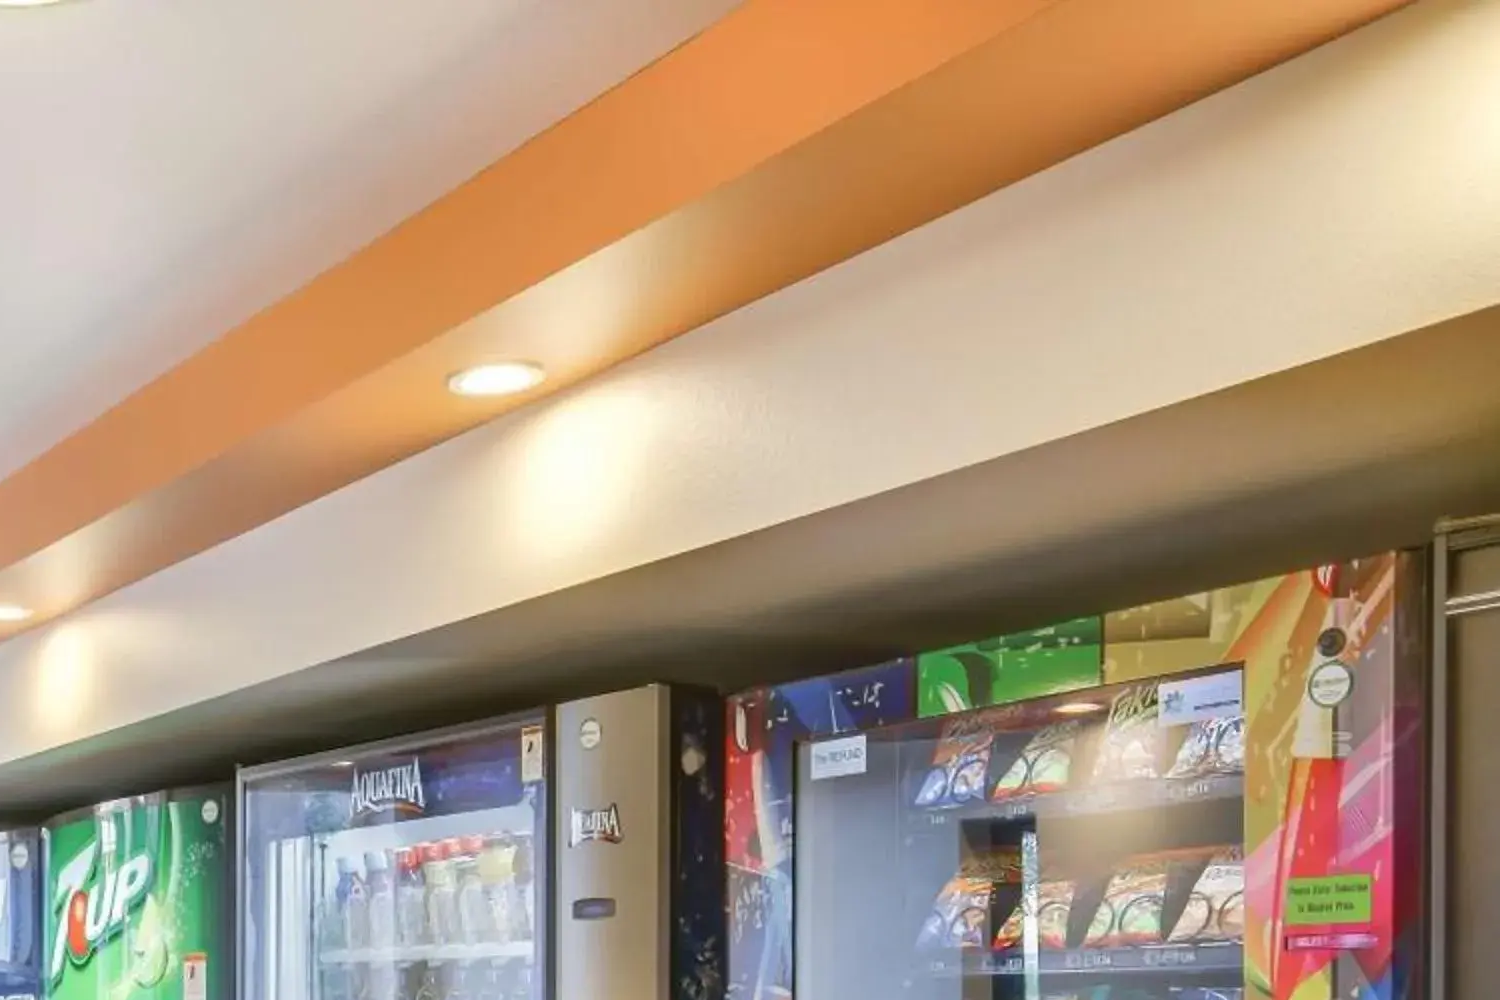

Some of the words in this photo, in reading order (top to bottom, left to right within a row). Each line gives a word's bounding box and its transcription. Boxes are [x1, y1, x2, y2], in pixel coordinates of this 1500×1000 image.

[350, 755, 425, 817] AQUAFINA
[569, 803, 620, 846] UAFINA
[51, 839, 150, 977] 7UP
